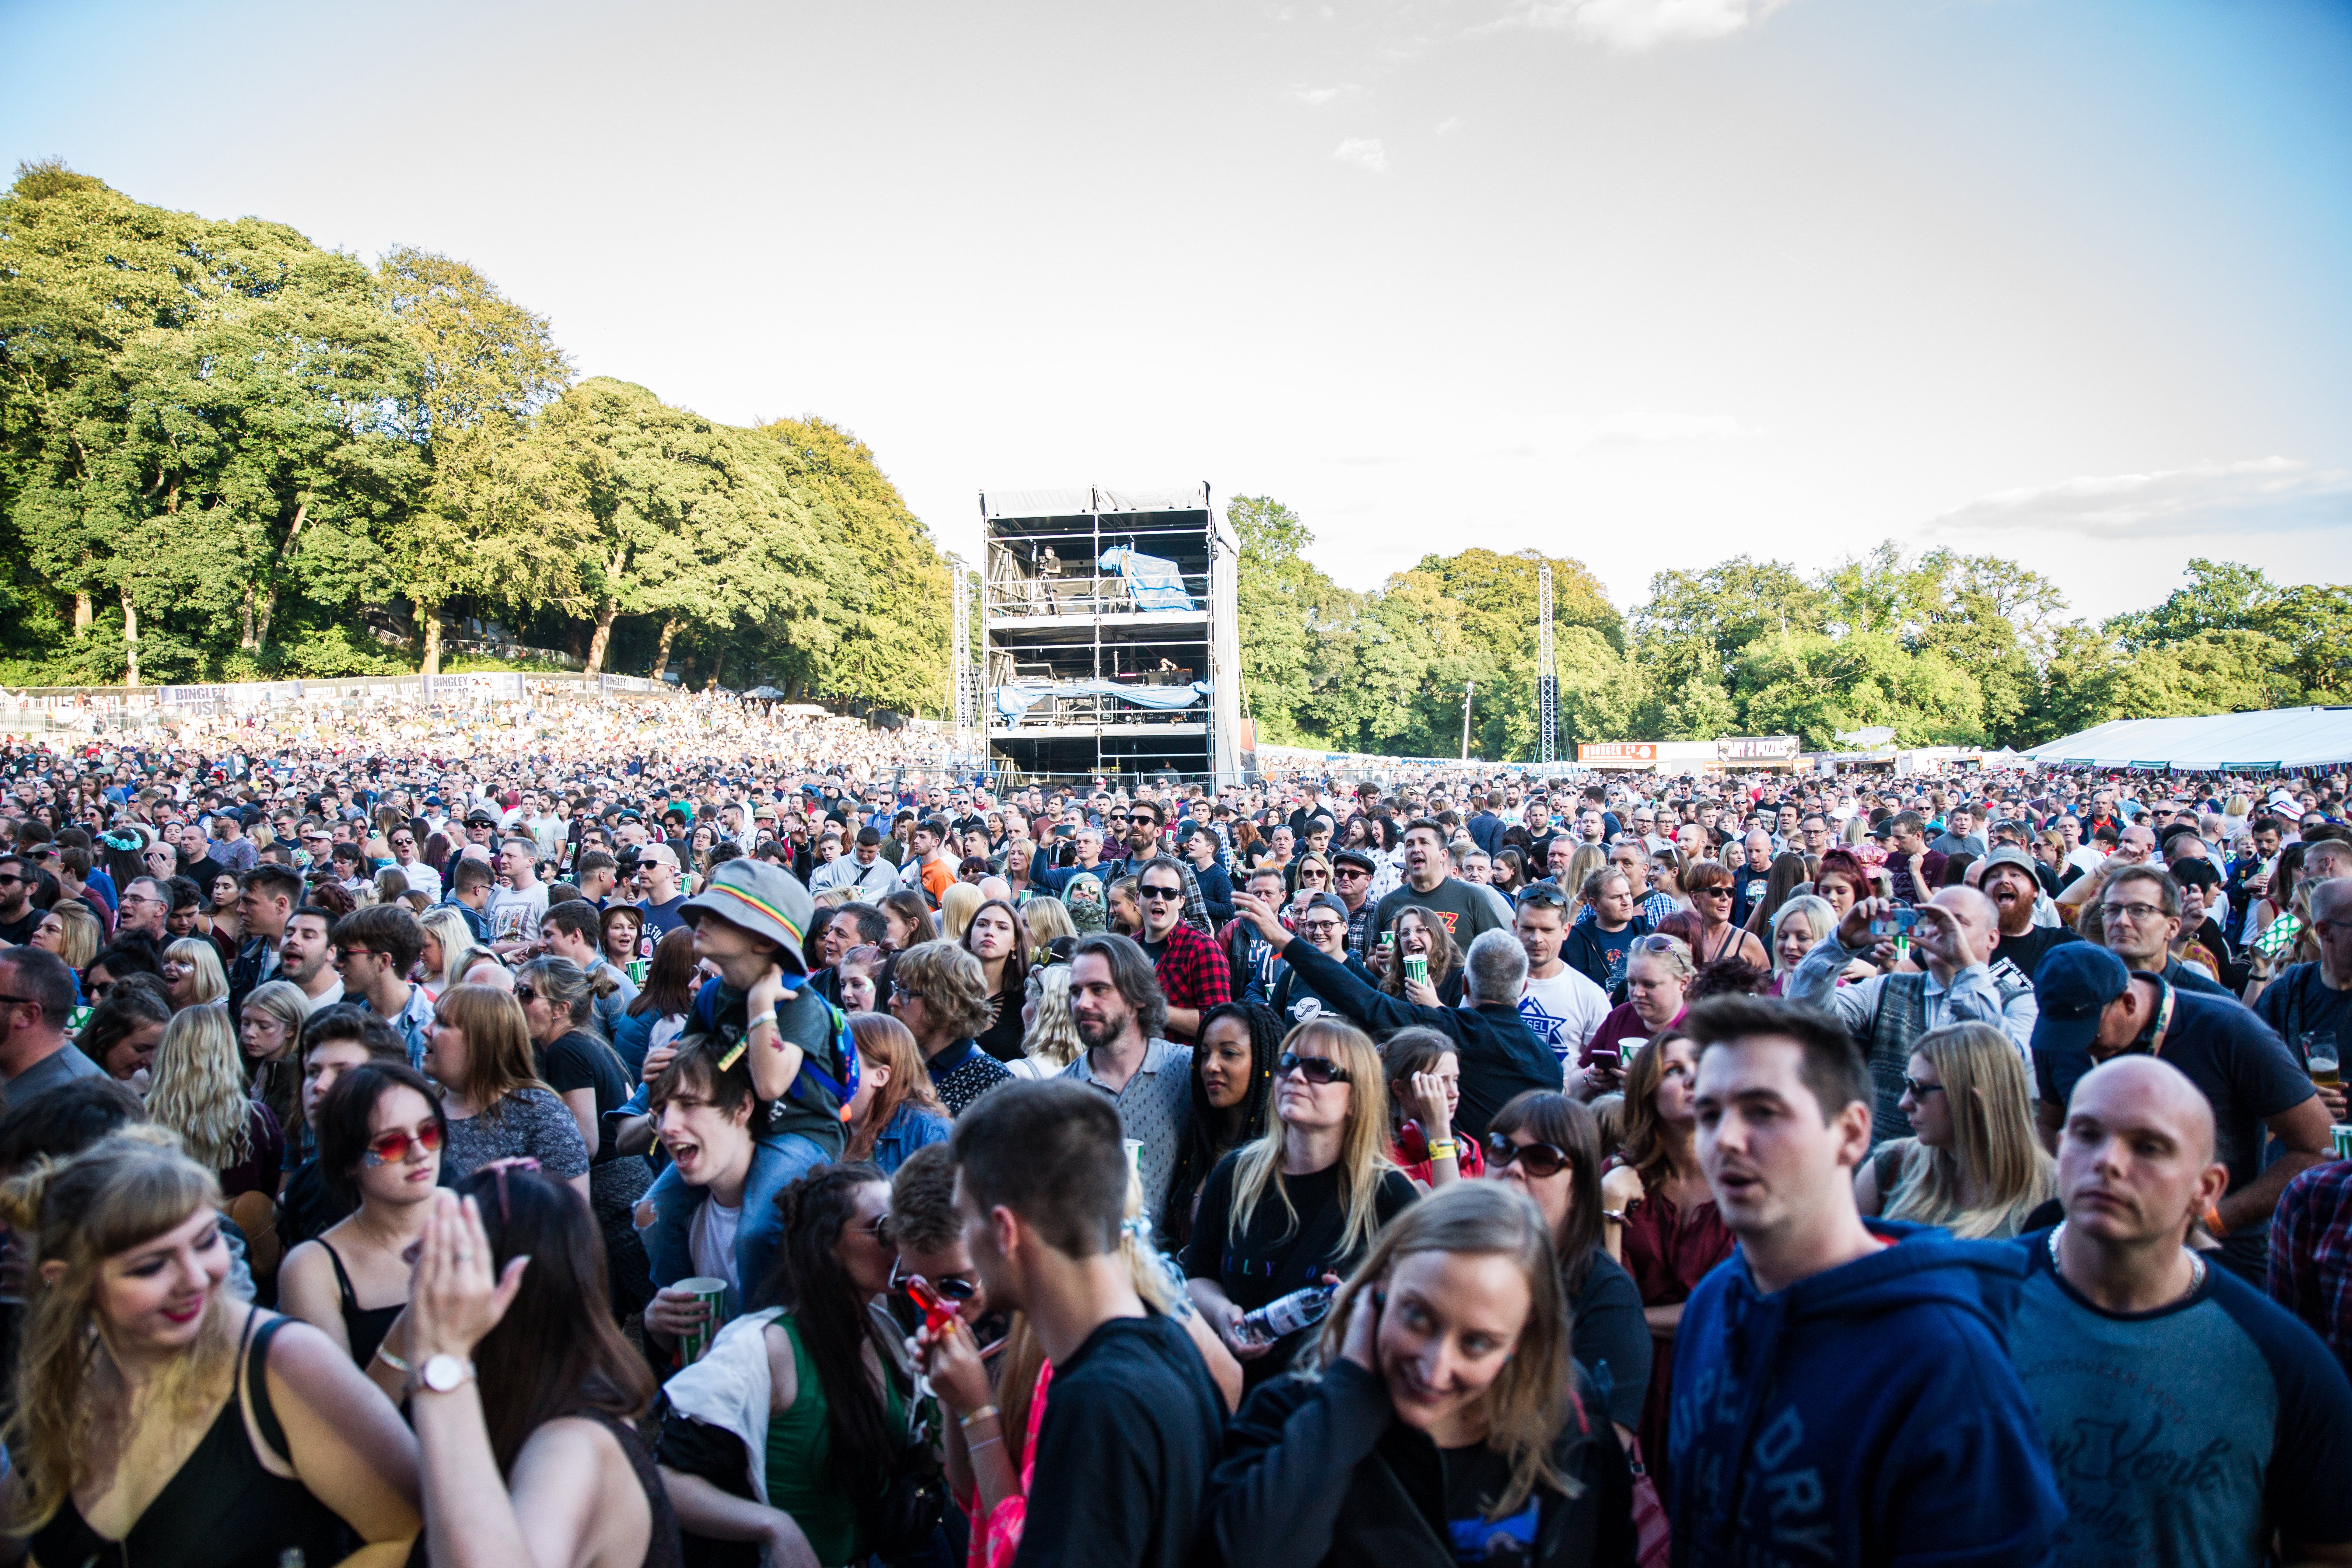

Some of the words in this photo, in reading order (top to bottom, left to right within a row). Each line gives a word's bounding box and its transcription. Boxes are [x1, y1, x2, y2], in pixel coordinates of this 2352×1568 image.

[433, 676, 469, 687] BINGLEY
[606, 676, 626, 687] BINGLEY
[434, 688, 469, 700] UIC
[1747, 741, 1755, 757] 2
[2007, 961, 2021, 975] LOVE
[1522, 1019, 1546, 1031] SEL
